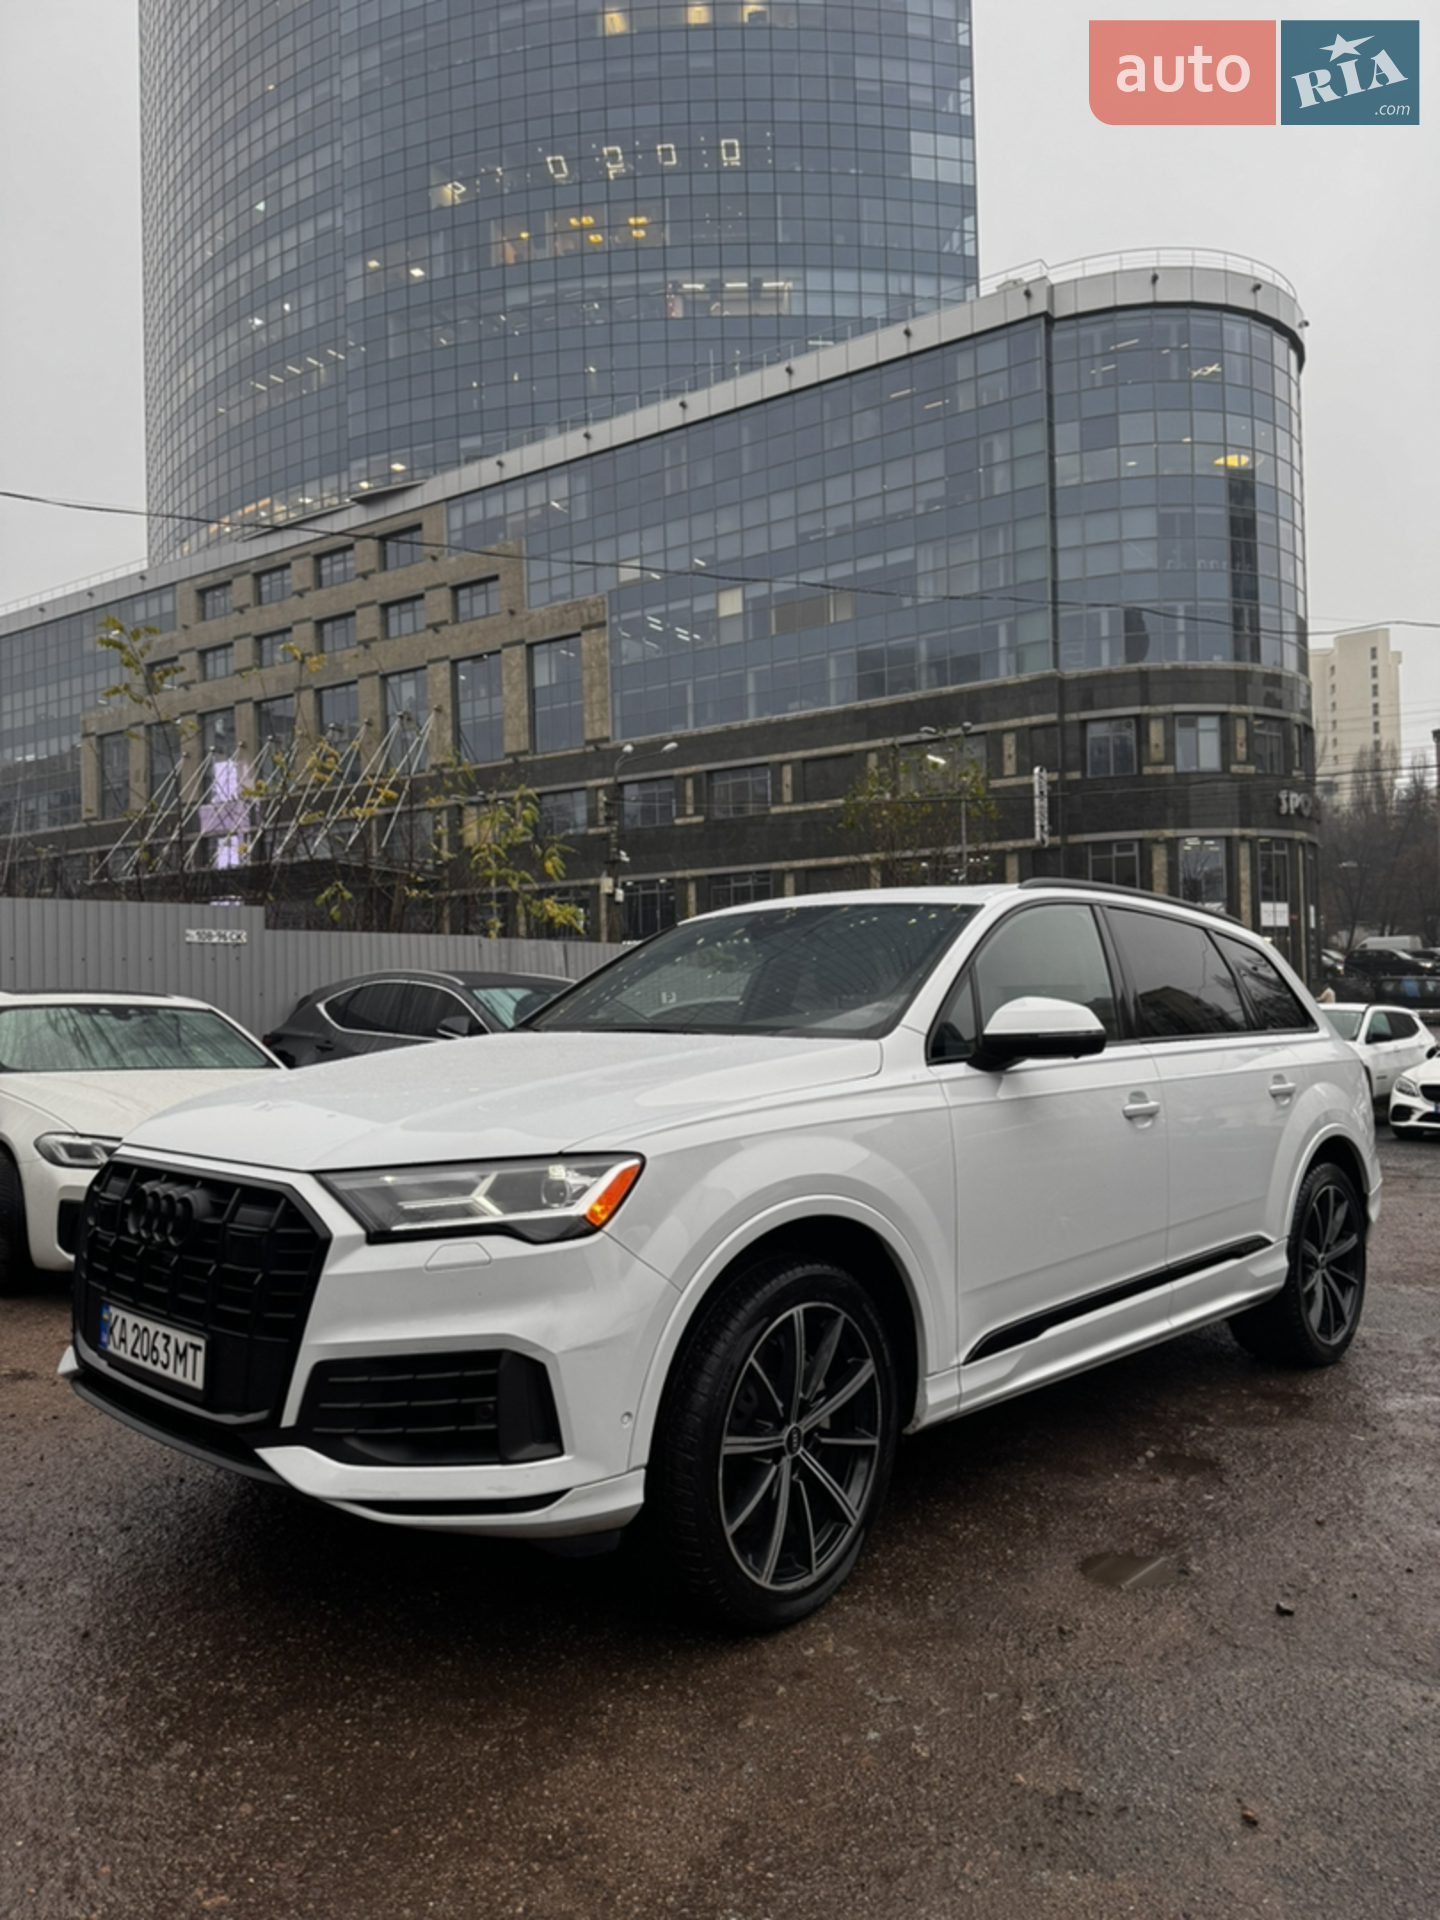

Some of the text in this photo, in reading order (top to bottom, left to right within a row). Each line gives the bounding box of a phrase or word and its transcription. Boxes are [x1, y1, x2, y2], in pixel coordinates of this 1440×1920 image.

[108, 1312, 203, 1382] KA 2063 MT
